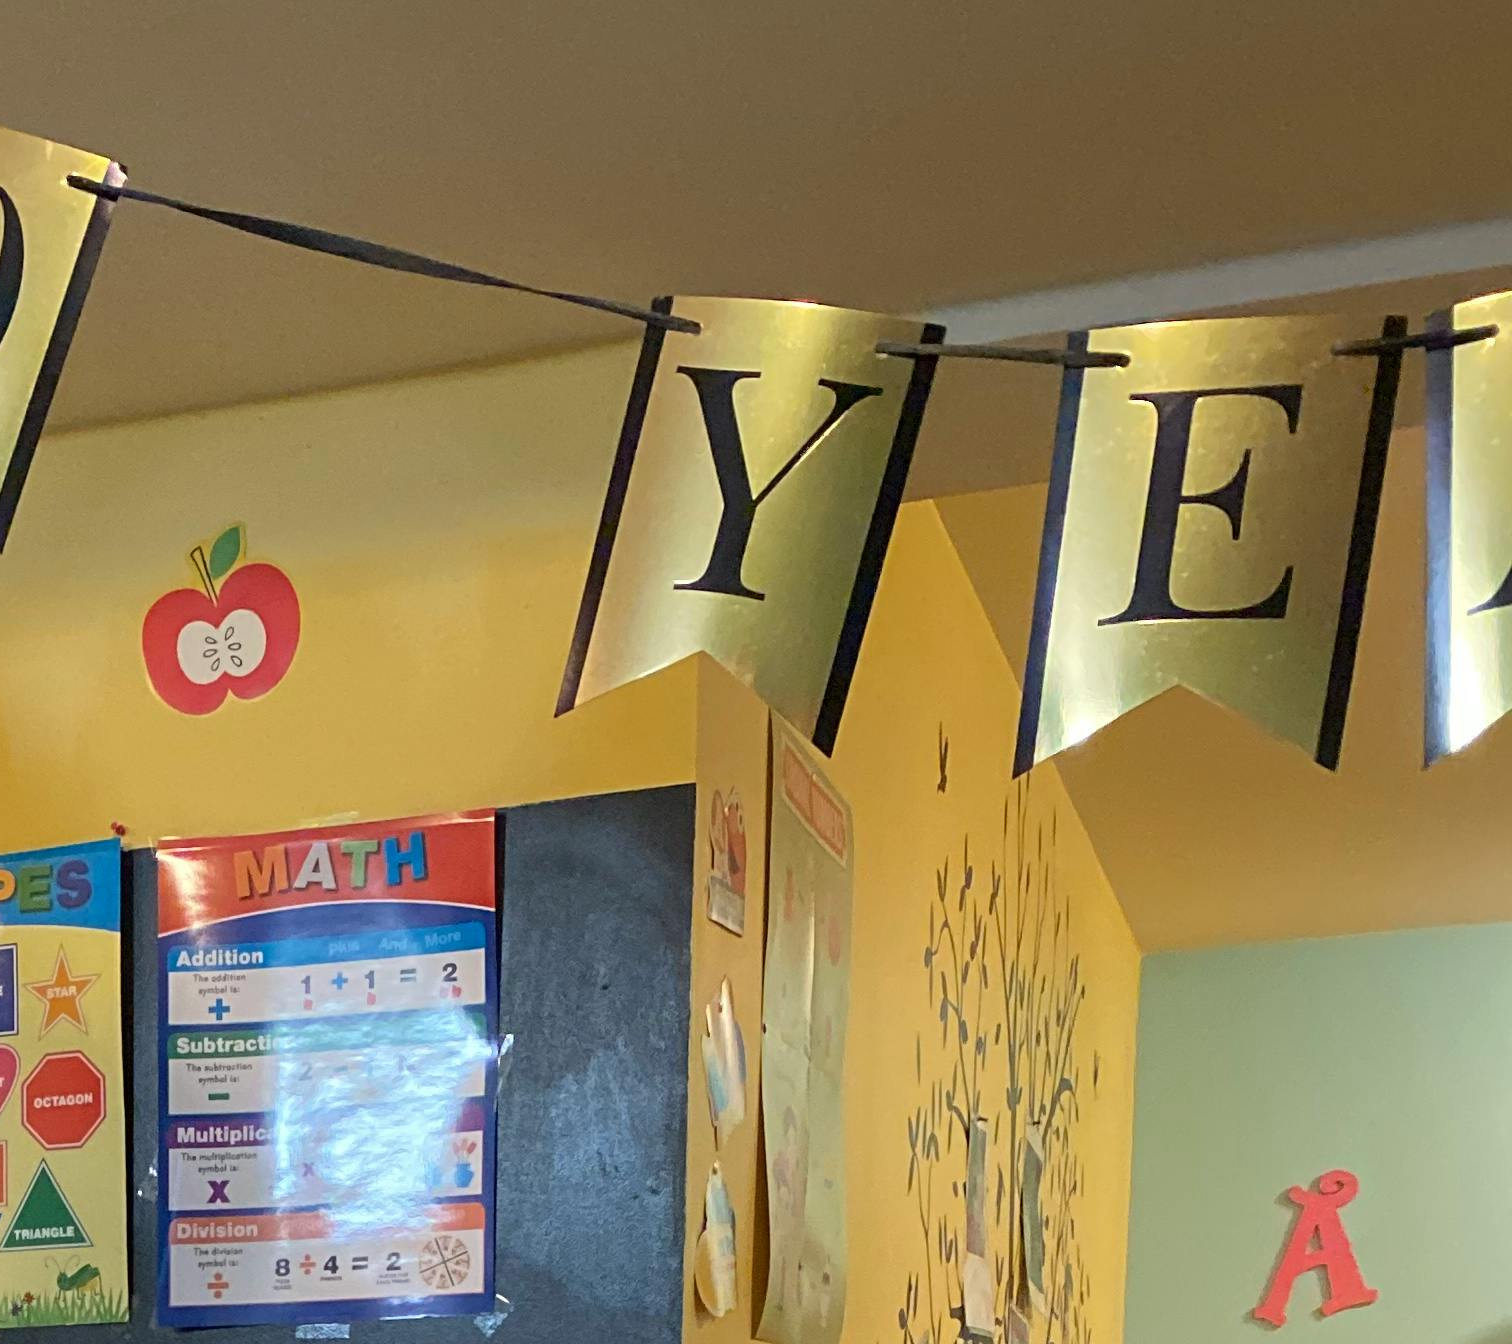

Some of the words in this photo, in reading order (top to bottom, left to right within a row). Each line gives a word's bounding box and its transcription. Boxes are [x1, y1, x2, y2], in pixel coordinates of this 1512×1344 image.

[234, 831, 427, 900] MATH
[176, 950, 264, 967] Addition
[300, 976, 311, 994] 1
[365, 970, 375, 989] 1
[442, 963, 458, 983] 2
[47, 986, 77, 998] STAR
[34, 1093, 93, 1108] OCTAGON
[14, 1226, 75, 1240] TRIANGLE
[177, 1222, 258, 1240] Division
[1253, 1170, 1378, 1328] A
[275, 1259, 290, 1276] 8
[323, 1256, 338, 1274] 4
[386, 1252, 402, 1271] 2
